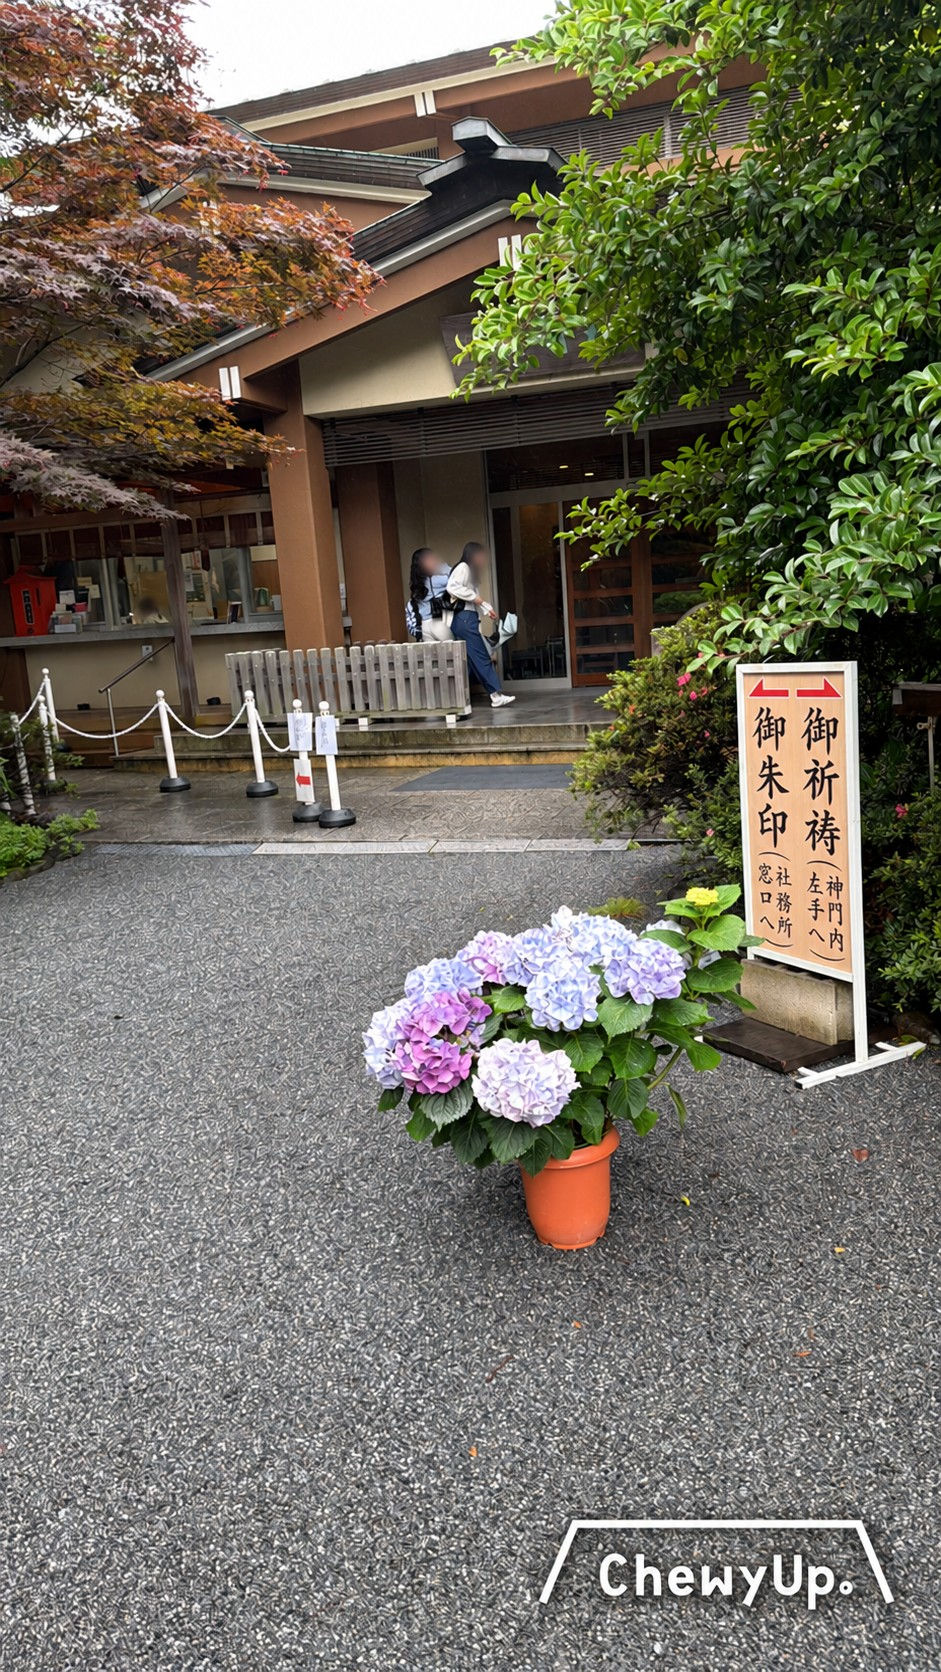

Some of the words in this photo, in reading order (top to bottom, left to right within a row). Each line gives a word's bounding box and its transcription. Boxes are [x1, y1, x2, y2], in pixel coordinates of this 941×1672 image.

[752, 706, 790, 848] 御朱印
[801, 706, 841, 856] 御祈祷
